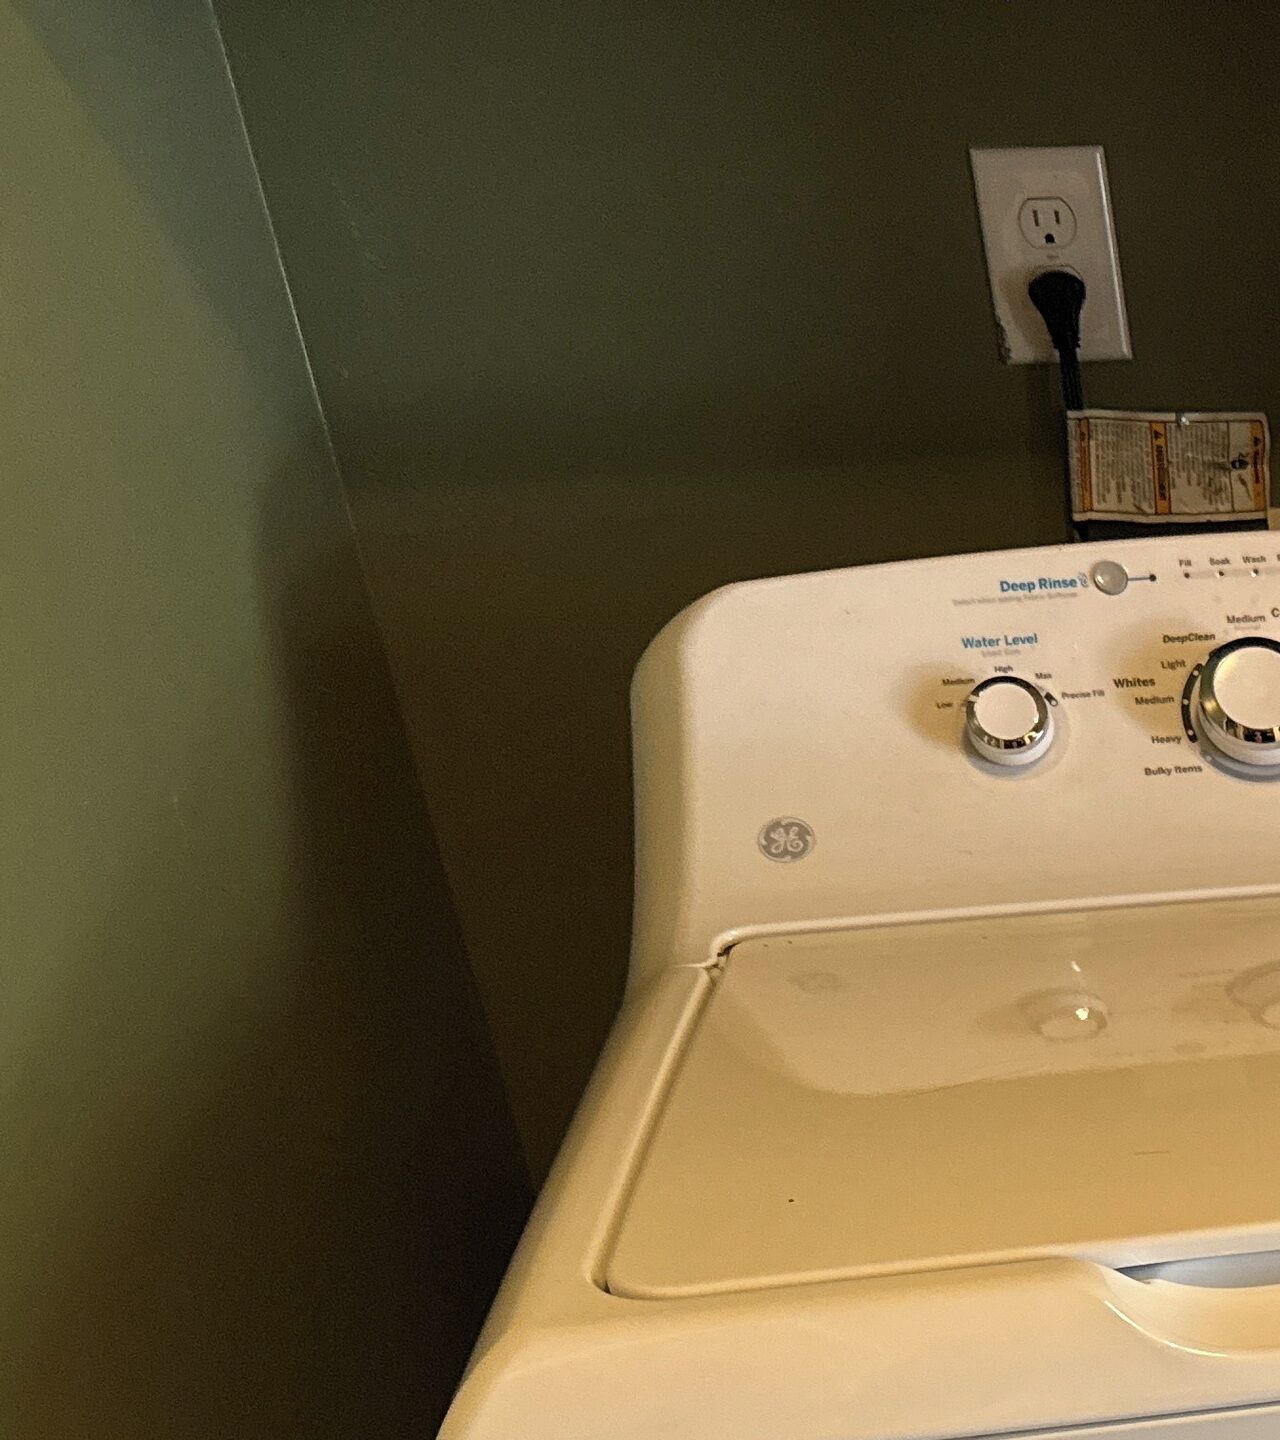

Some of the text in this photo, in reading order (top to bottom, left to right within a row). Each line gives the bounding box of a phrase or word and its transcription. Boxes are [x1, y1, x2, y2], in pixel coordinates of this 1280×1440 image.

[1179, 559, 1192, 567] Fill
[1242, 555, 1267, 564] Wash
[1000, 577, 1078, 593] Deep Rinse
[1226, 614, 1266, 624] Medium
[961, 633, 1038, 649] Water Level
[1162, 633, 1216, 644] DeepClean
[1161, 659, 1187, 670] Light
[1113, 677, 1156, 689] Whites
[1135, 695, 1175, 705] Medium
[1151, 735, 1182, 745] Heavy
[1144, 767, 1173, 776] Bulky
